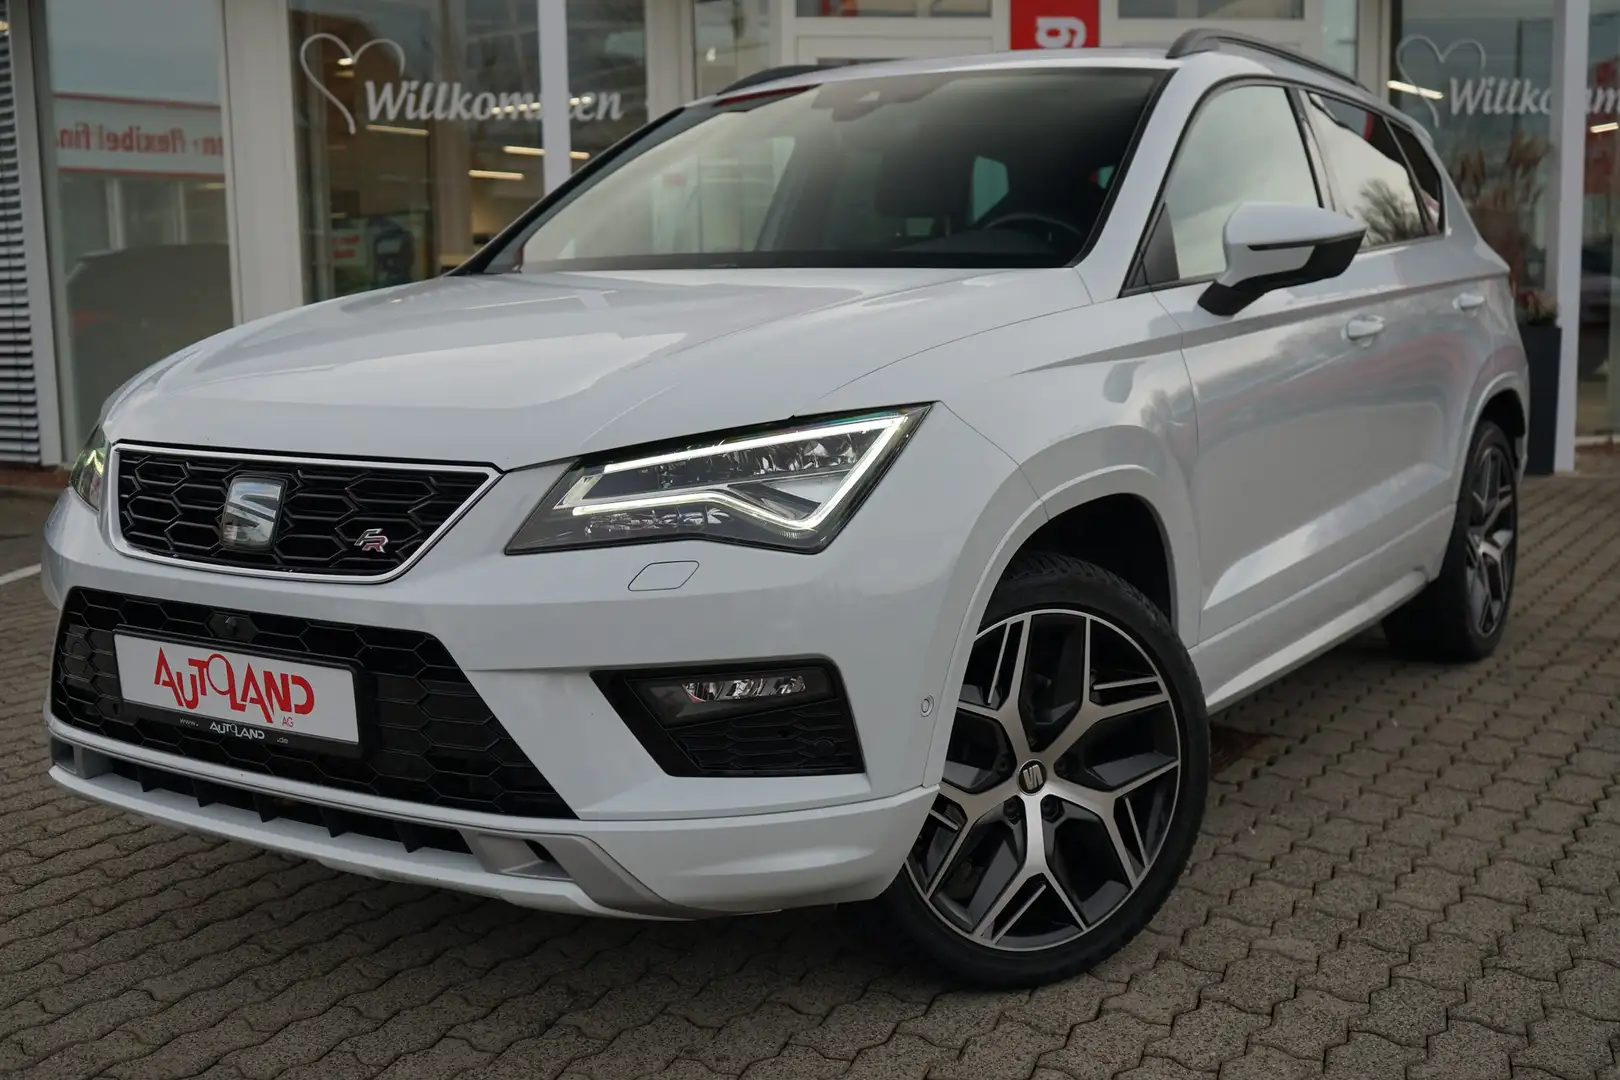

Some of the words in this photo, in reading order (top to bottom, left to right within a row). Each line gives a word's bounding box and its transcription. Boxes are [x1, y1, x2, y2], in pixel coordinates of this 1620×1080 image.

[365, 80, 625, 121] Willkomen
[354, 528, 388, 553] FR
[281, 716, 294, 728] AG
